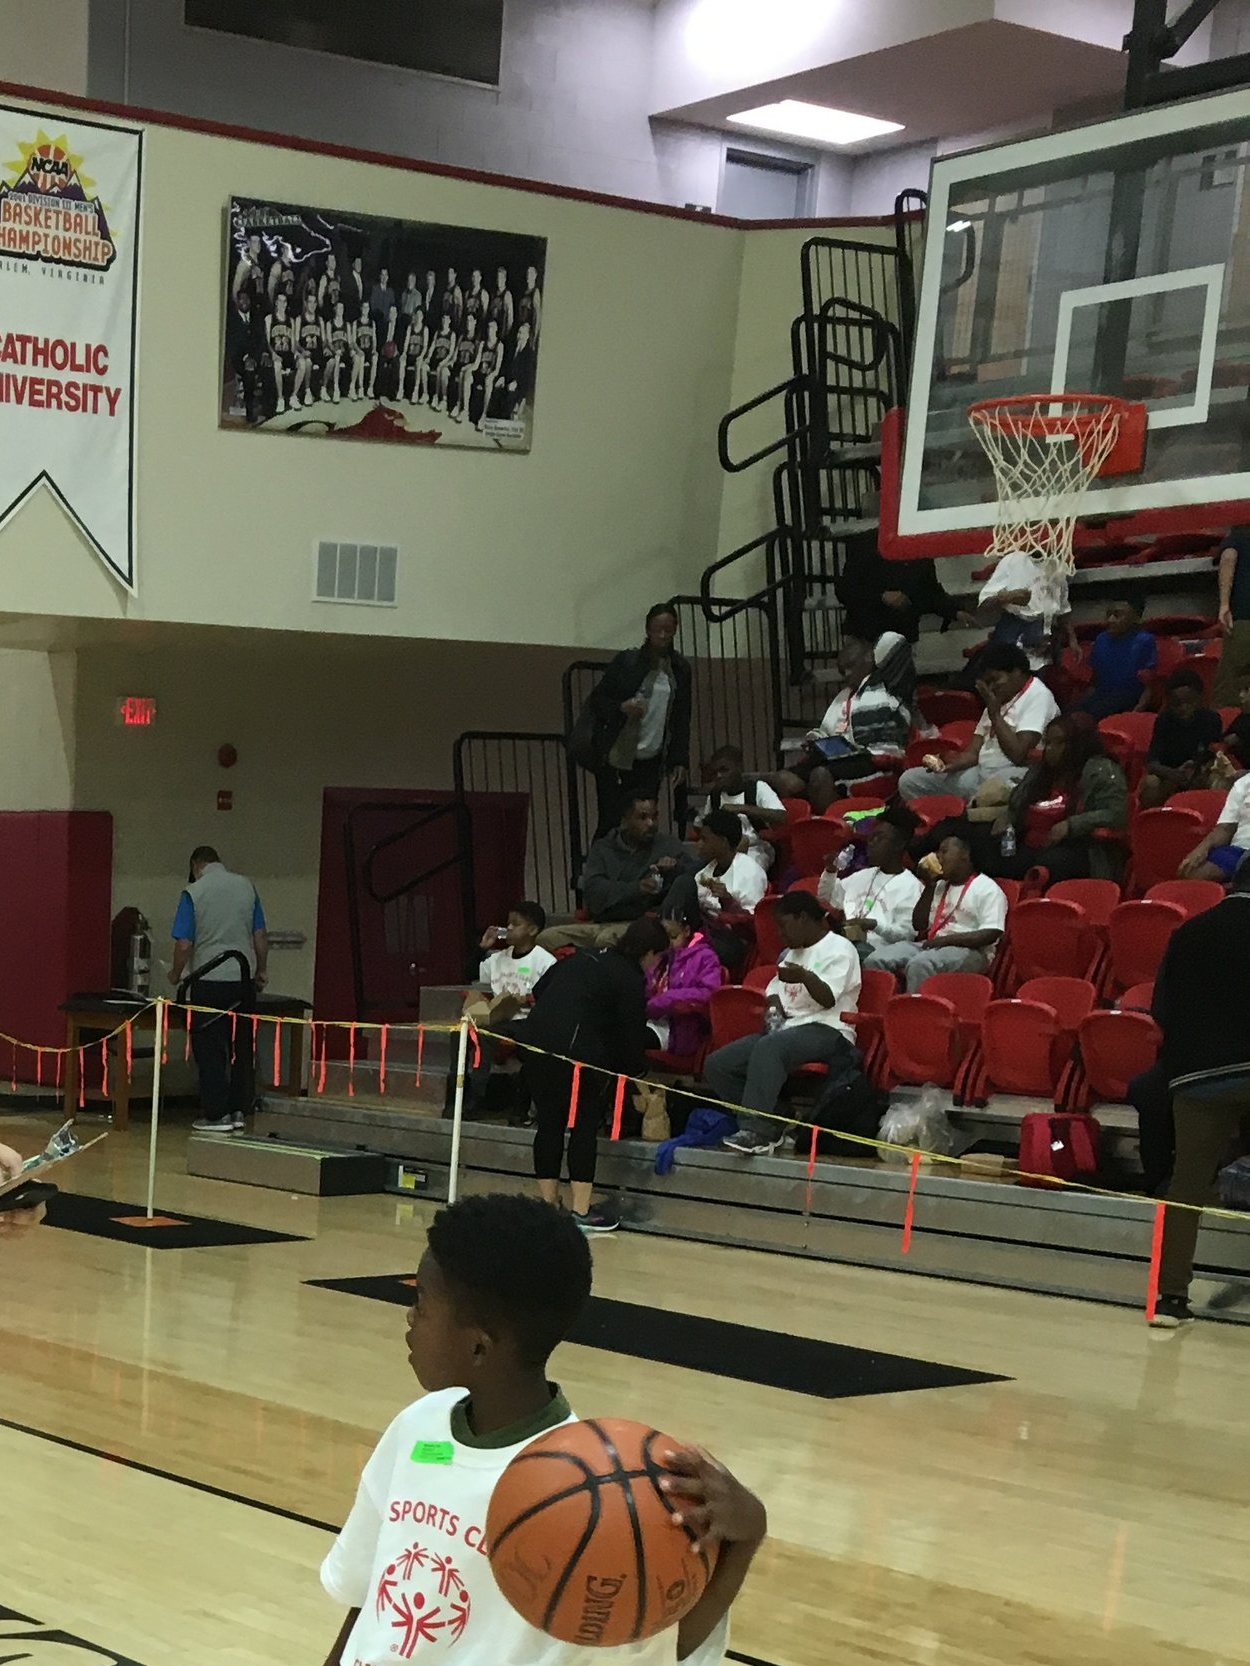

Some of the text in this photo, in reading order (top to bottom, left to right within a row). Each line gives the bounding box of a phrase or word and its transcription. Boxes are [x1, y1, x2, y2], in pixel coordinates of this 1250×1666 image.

[31, 157, 69, 176] NCAA
[28, 193, 60, 208] DIVISION
[2, 200, 100, 238] BASKETBALL
[41, 266, 105, 285] VIRGINIA
[125, 696, 153, 725] EXIT
[389, 1500, 460, 1536] SPORTS
